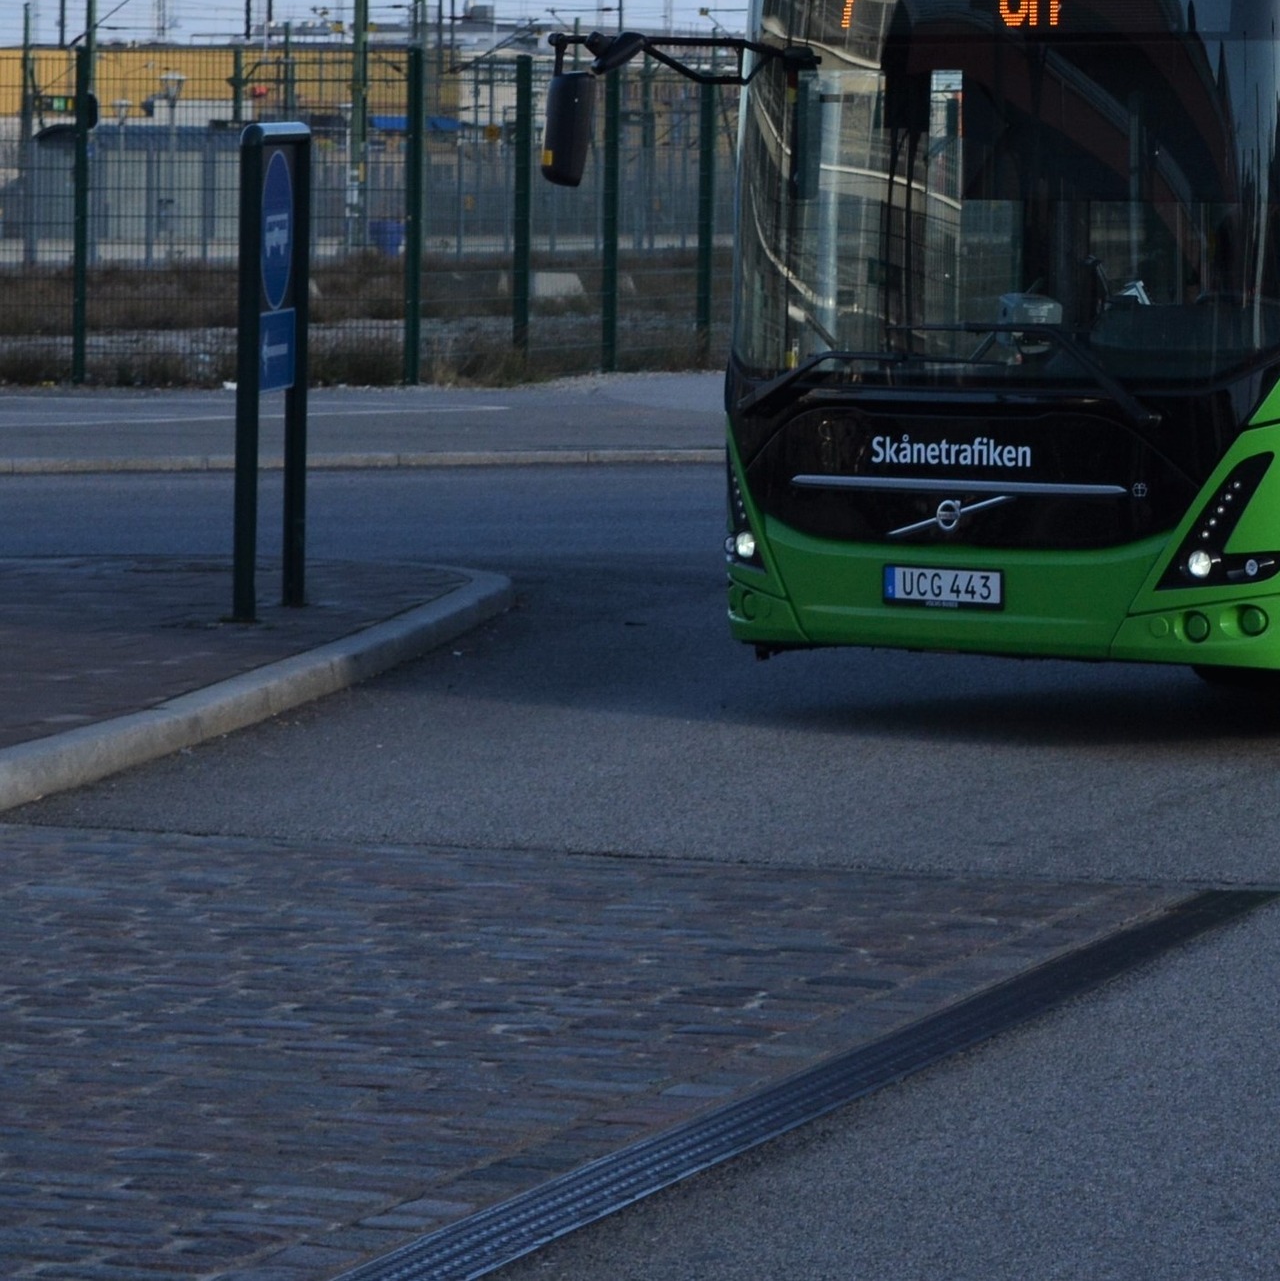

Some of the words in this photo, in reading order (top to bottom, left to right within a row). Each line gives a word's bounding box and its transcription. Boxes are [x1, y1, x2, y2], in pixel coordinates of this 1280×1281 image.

[871, 434, 1031, 467] Skånetrafiken
[902, 571, 942, 597] UCG
[950, 574, 991, 600] 443
